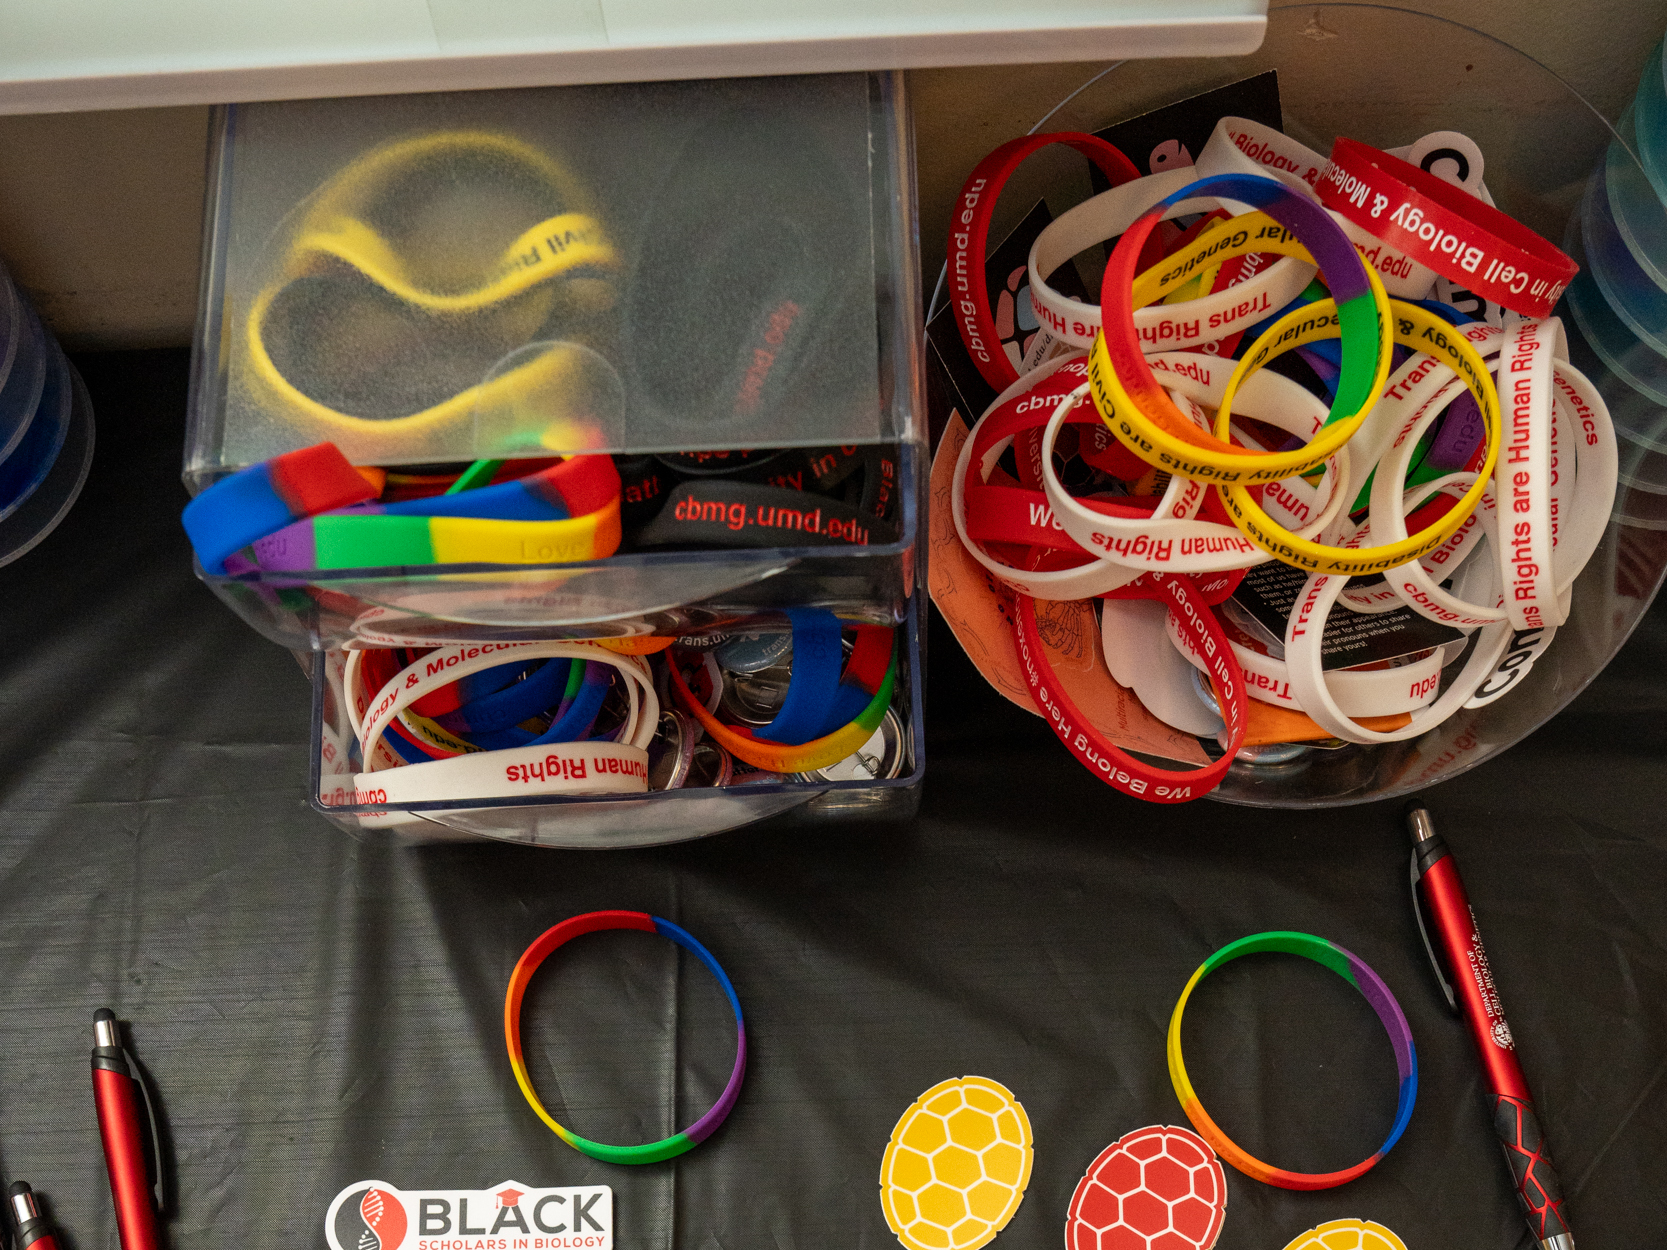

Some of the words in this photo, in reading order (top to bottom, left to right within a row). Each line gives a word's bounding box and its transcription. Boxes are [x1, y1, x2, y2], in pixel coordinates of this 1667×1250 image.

[1371, 193, 1389, 218] &
[1160, 230, 1248, 287] Genetics
[1390, 203, 1484, 273] Biology
[954, 178, 990, 363] cbmg.umd.edu
[1484, 259, 1529, 295] Cell
[1208, 292, 1271, 328] Trans
[1399, 318, 1414, 335] &
[1422, 327, 1484, 400] Biology
[1510, 323, 1540, 373] Rights
[1120, 421, 1154, 453] are
[1508, 378, 1531, 464] Human
[1160, 453, 1241, 482] Rights
[1222, 484, 1243, 519] are
[1512, 471, 1530, 514] are
[675, 496, 869, 546] cbmg.umd.edu
[1091, 530, 1172, 562] Rights
[1181, 535, 1255, 556] Human
[1247, 522, 1318, 569] Rights
[1327, 534, 1442, 573] Disability
[1511, 522, 1540, 602] Rights
[1167, 580, 1217, 658] Biology
[1291, 576, 1328, 642] Trans
[1341, 626, 1354, 634] for
[1355, 620, 1380, 632] others
[1380, 618, 1389, 626] to
[1389, 613, 1411, 624] share
[1390, 623, 1405, 632] you
[405, 672, 420, 689] &
[1215, 656, 1234, 700] Cell
[1039, 688, 1073, 738] Here
[507, 749, 586, 789] Rights
[594, 757, 648, 784] Human
[1073, 733, 1149, 795] Belong
[1467, 950, 1476, 962] OF
[1474, 943, 1492, 990] BIOLOGY
[1471, 963, 1494, 1018] DEPARTMENT
[418, 1193, 605, 1235] BLACK
[418, 1239, 507, 1250] SCHOLARS
[513, 1239, 529, 1250] IN
[534, 1236, 605, 1249] BIOLOGY
